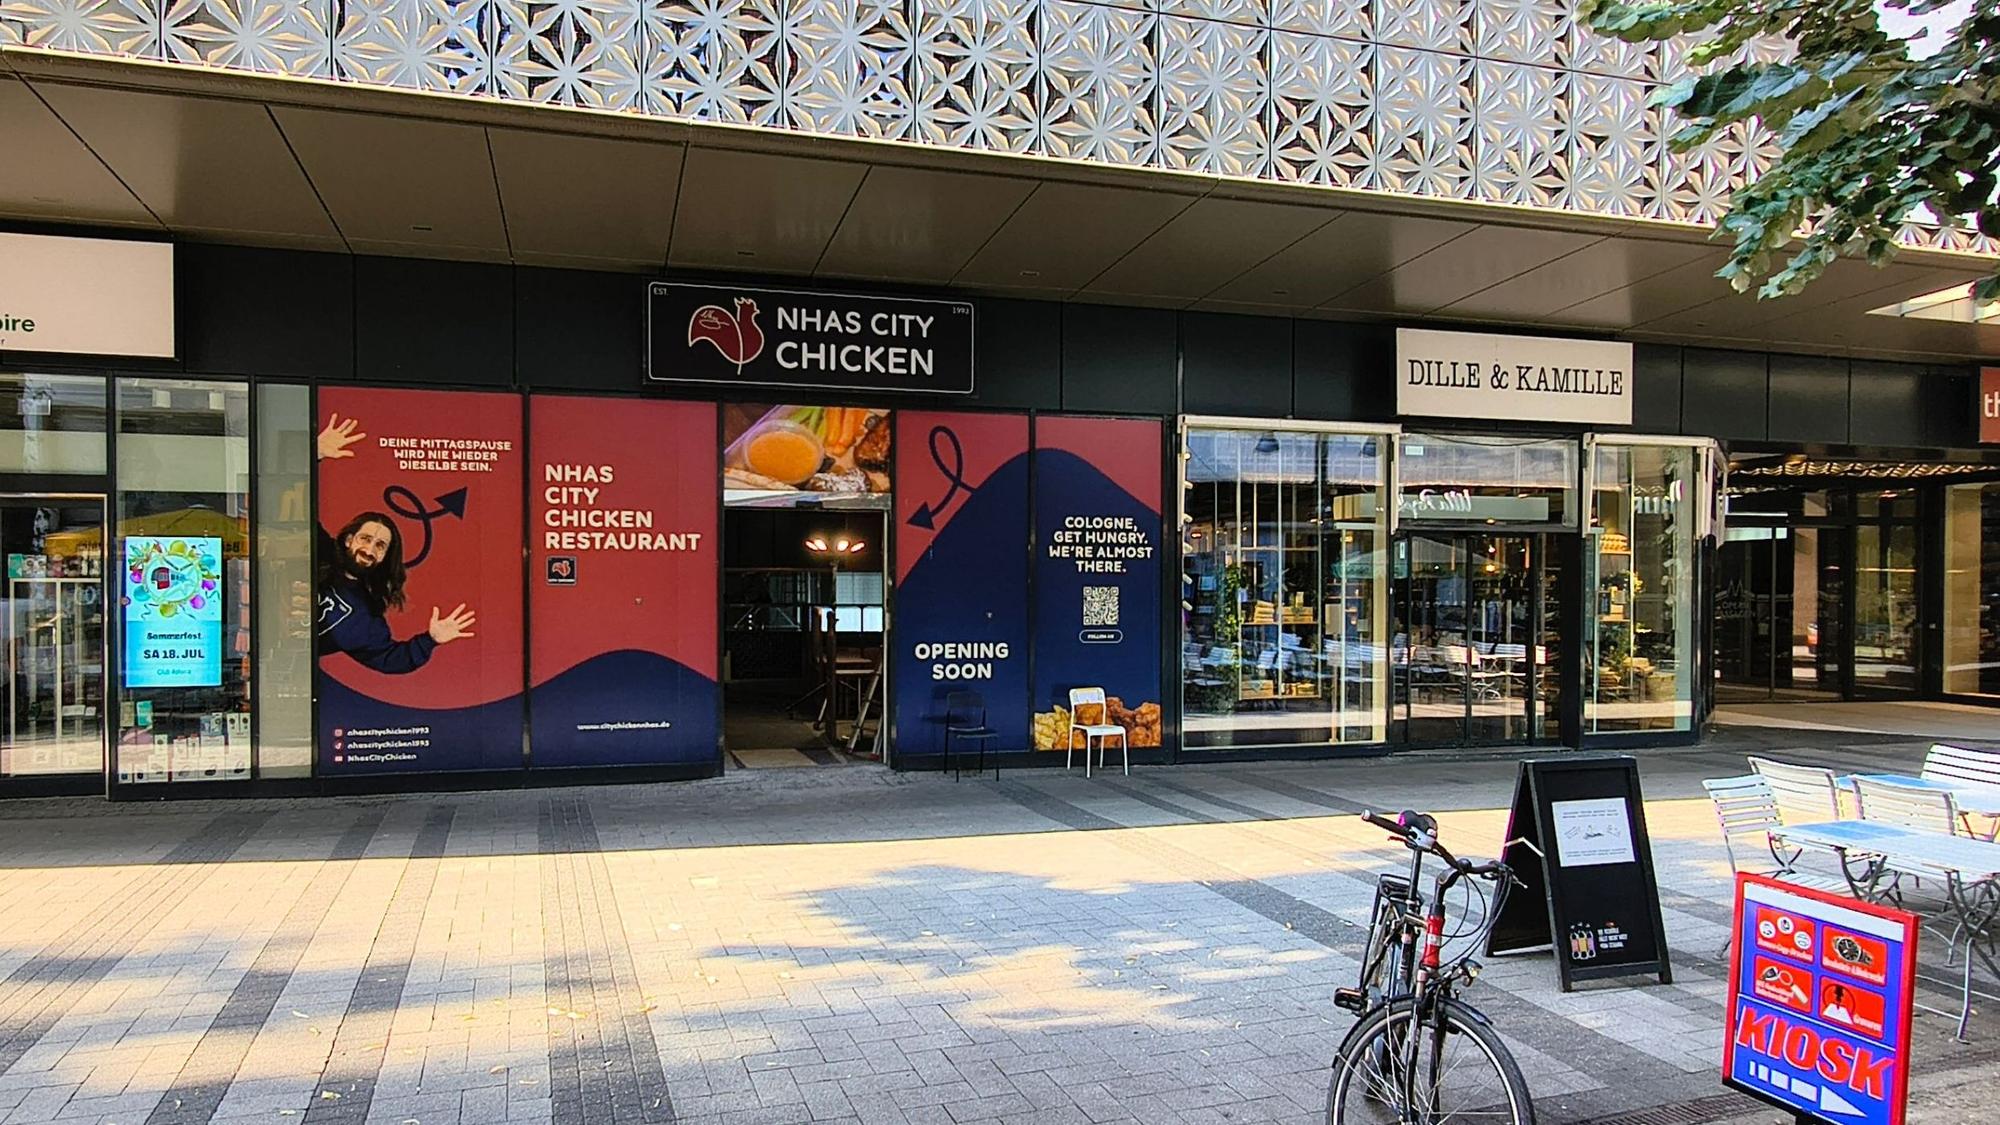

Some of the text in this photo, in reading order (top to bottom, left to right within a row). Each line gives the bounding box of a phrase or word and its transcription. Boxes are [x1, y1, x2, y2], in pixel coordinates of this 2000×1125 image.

[777, 307, 934, 338] NHAS CITY
[776, 341, 934, 376] CHICKEN
[1407, 358, 1624, 396] DILLE & KAMILLE
[379, 437, 512, 451] DEINE MITTAGSPAUSE
[393, 449, 498, 461] WIRD NIE WIEDER
[399, 460, 493, 472] DIESELBE SEIN.
[544, 464, 614, 483] NHAS
[544, 486, 600, 505] CITY
[544, 509, 654, 528] CHICKEN
[1064, 516, 1138, 532] COLOGNE,
[544, 531, 702, 551] RESTAURANT
[1053, 530, 1148, 544] GET HUNGRY.
[1048, 545, 1154, 559] WE'RE ALMOST
[1075, 560, 1127, 573] THERE.
[146, 631, 202, 640] Sommerfest
[143, 649, 205, 659] SA 18. JUL
[914, 642, 1009, 660] OPENING
[932, 663, 993, 680] SOON
[1736, 1005, 1896, 1101] KIOSK
